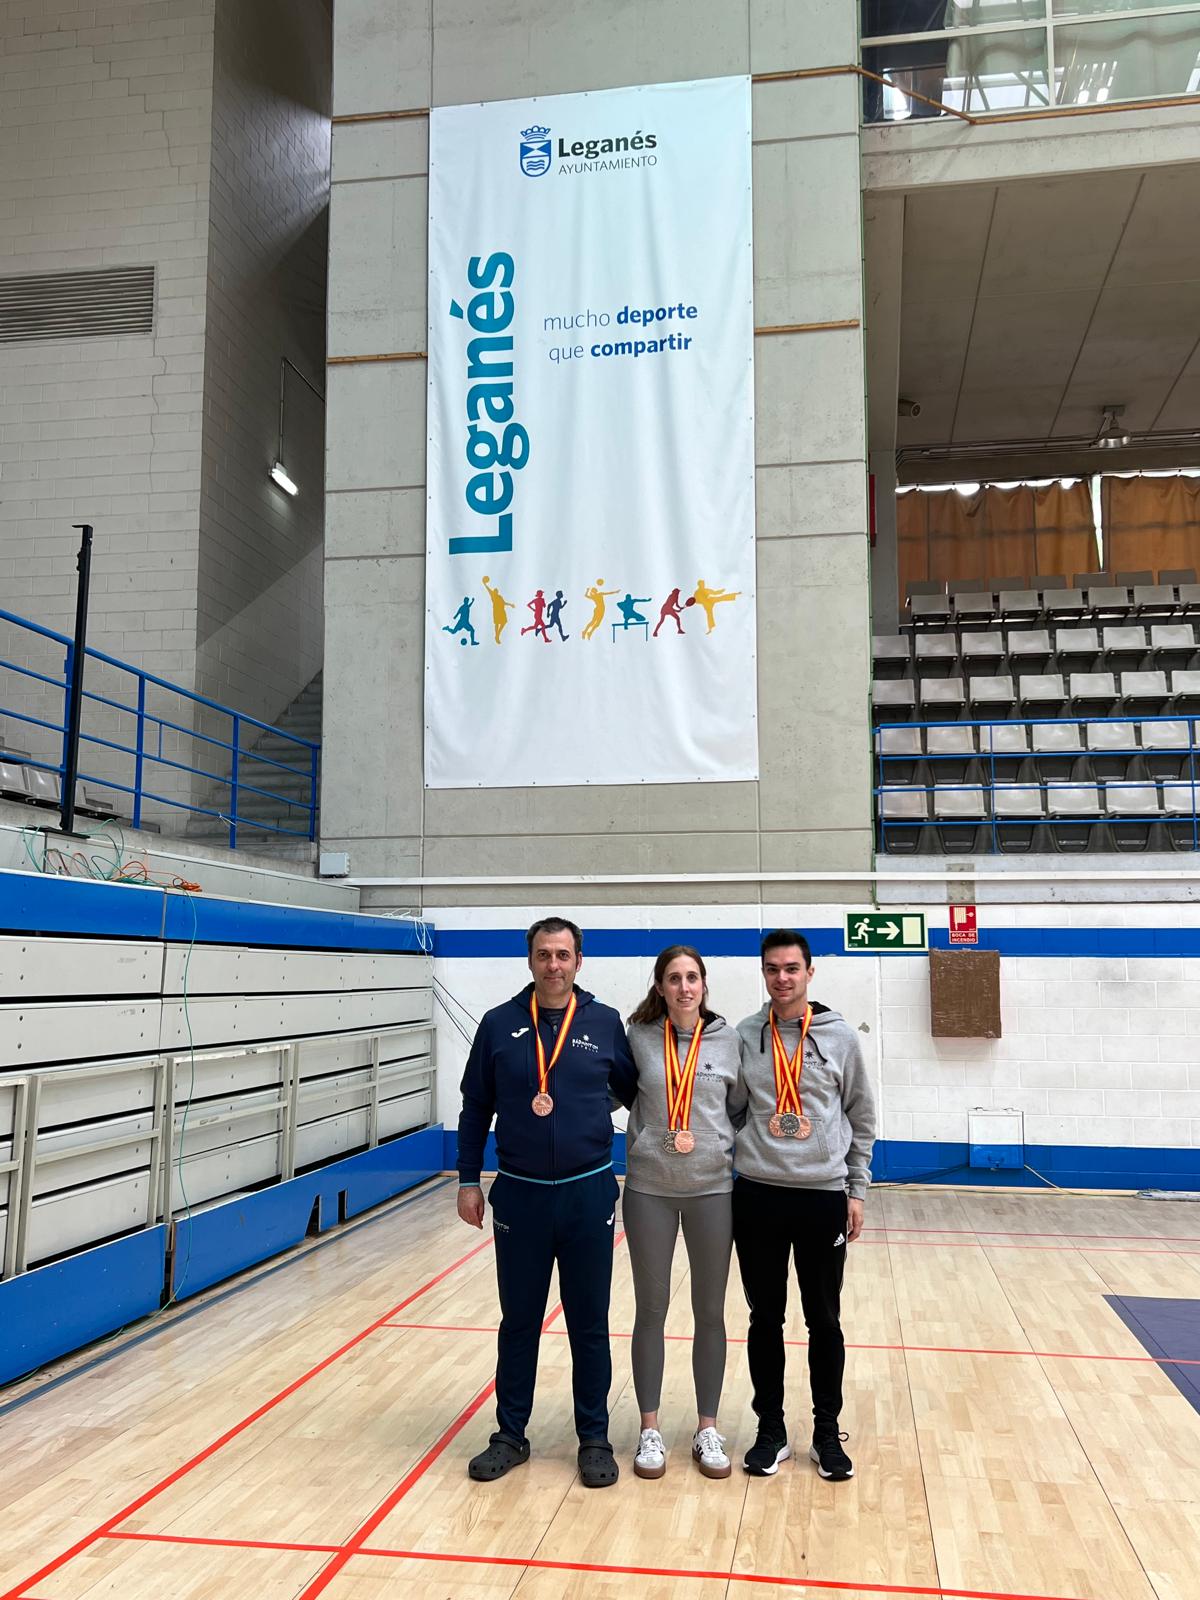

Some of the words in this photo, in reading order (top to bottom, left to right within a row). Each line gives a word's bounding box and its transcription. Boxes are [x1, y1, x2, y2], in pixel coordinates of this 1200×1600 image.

[558, 131, 657, 158] Leganés
[558, 154, 658, 175] AYUNTAMIENTO
[543, 309, 611, 331] mucho
[616, 302, 698, 327] deporte
[548, 344, 584, 364] que
[590, 332, 692, 358] compartir
[449, 251, 530, 555] Leganés
